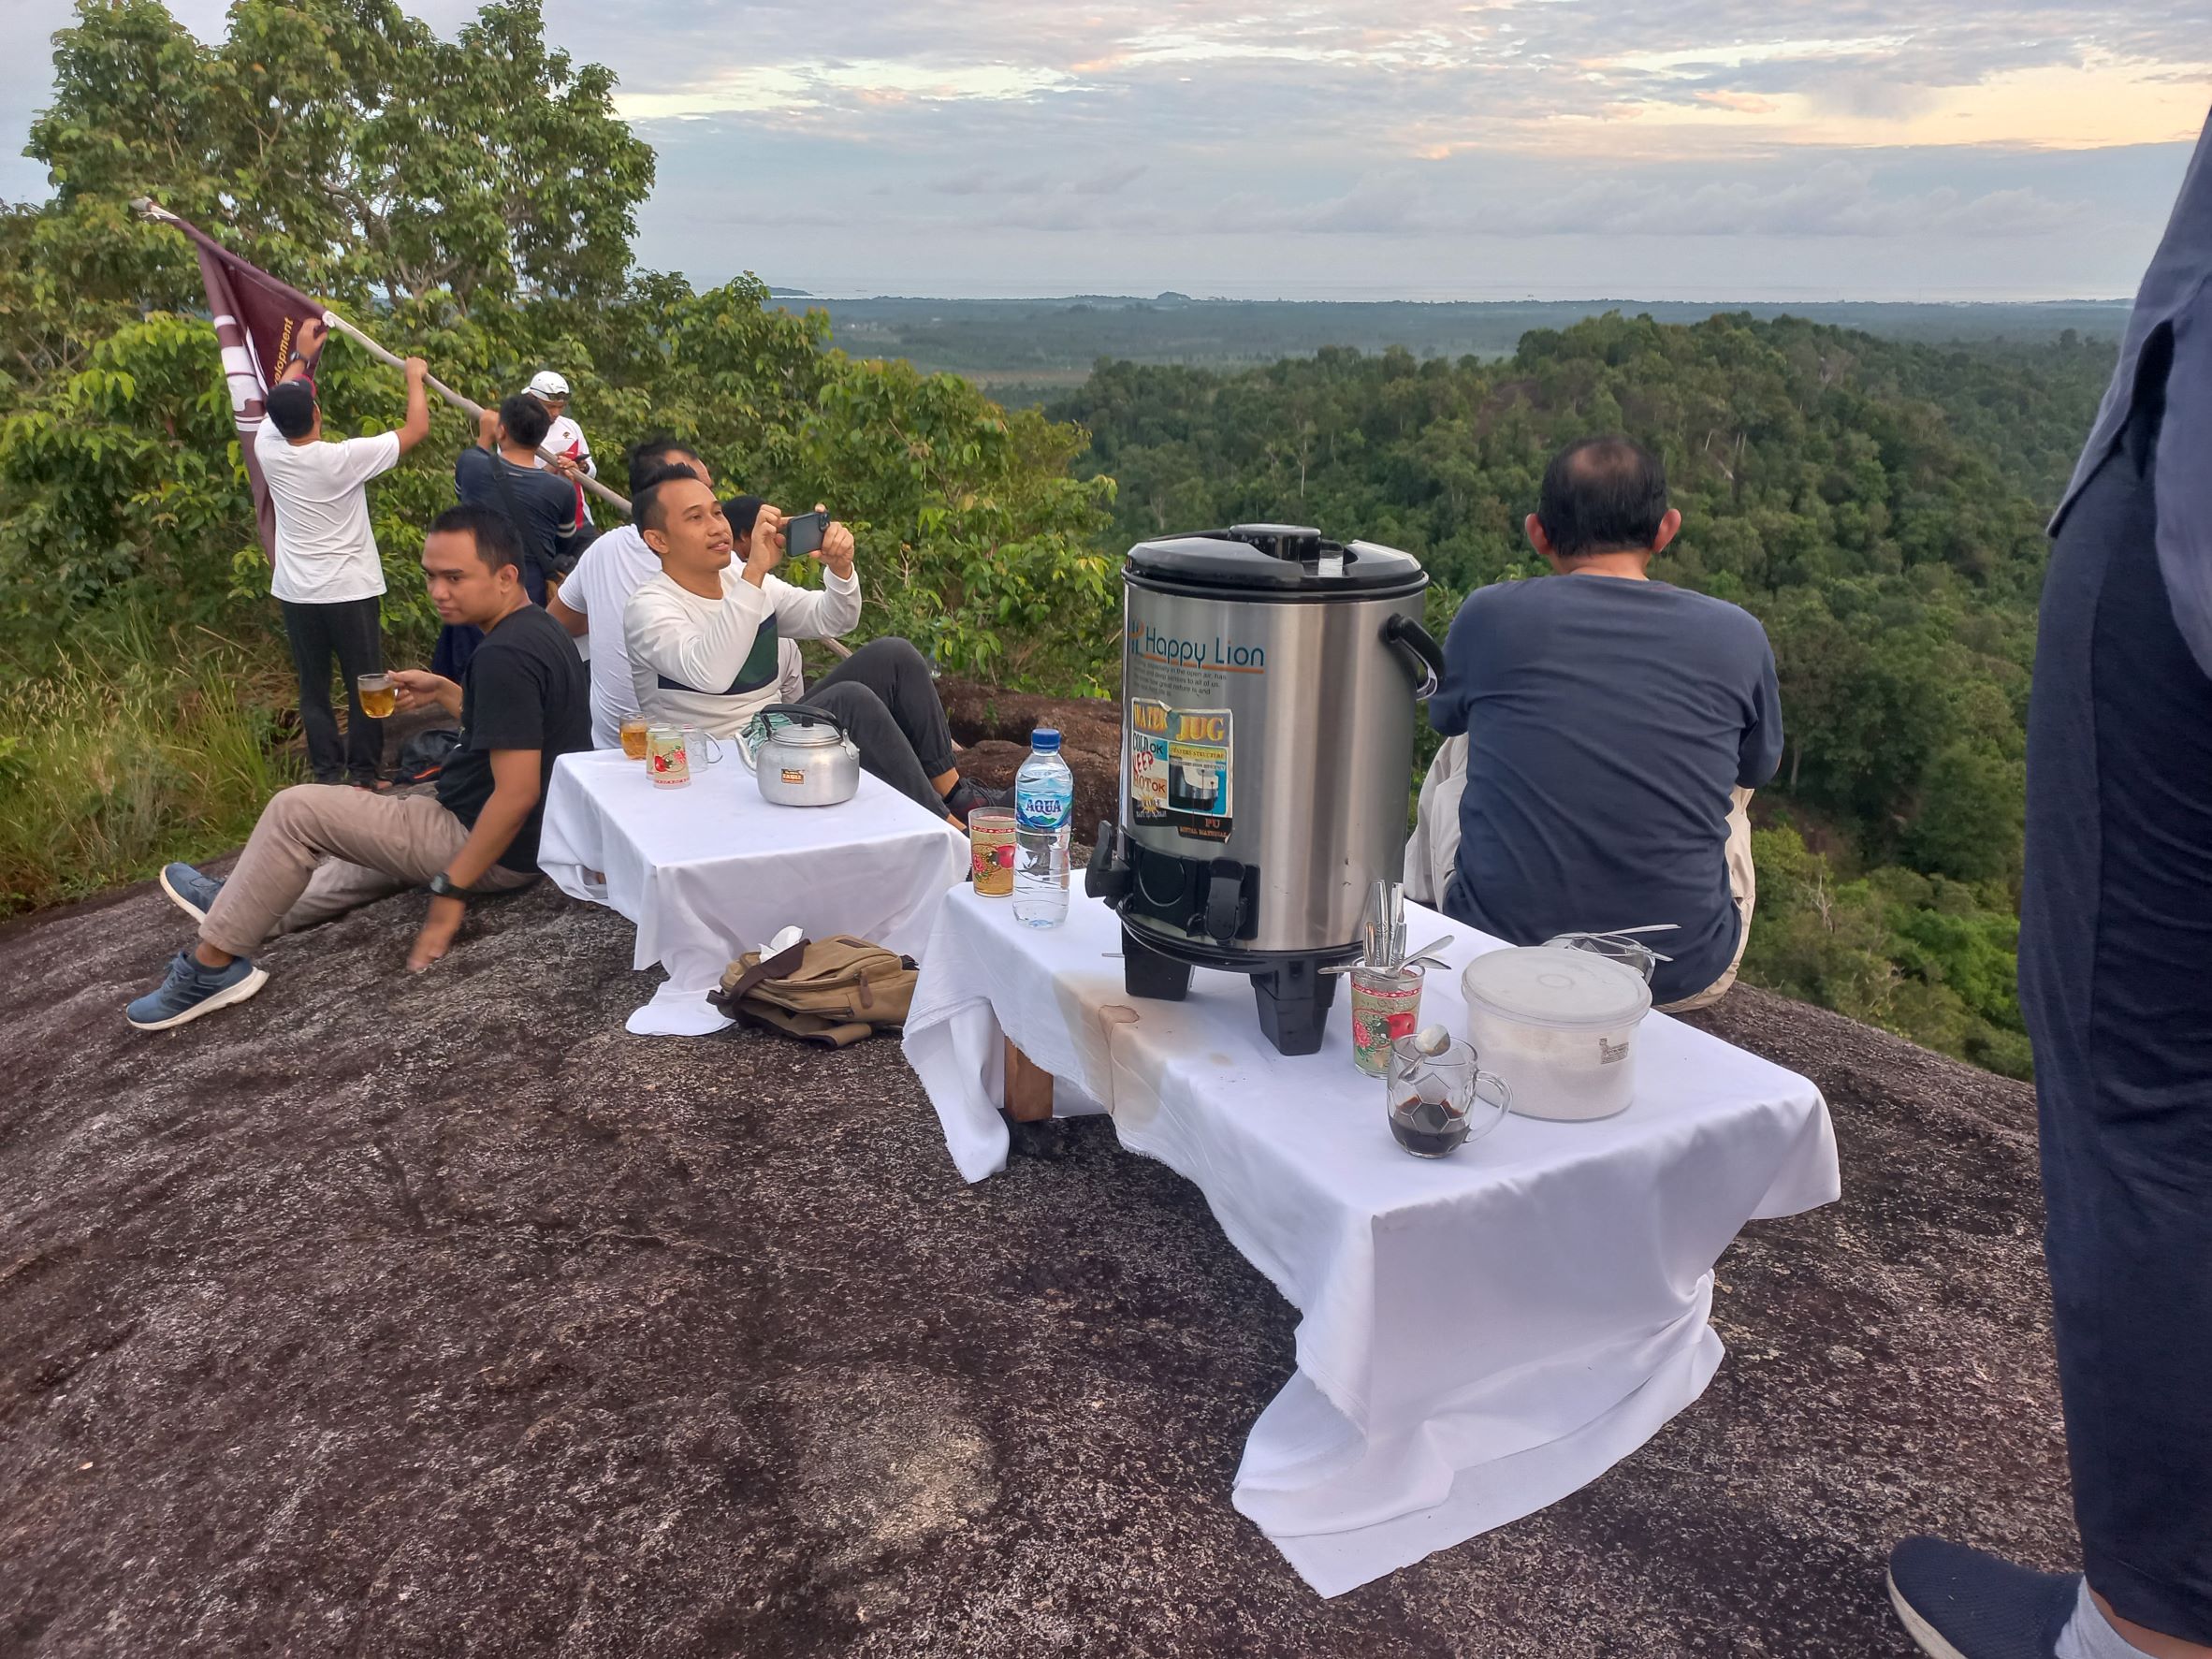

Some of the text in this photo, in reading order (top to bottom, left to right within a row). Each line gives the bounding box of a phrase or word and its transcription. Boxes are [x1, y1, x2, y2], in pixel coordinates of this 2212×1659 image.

[1146, 625, 1264, 669] Happy Lion
[1176, 715, 1225, 741] JUG
[1133, 732, 1163, 755] COLD OK
[1152, 781, 1166, 793] OK
[1026, 799, 1061, 815] AQUA
[1205, 818, 1220, 829] PU
